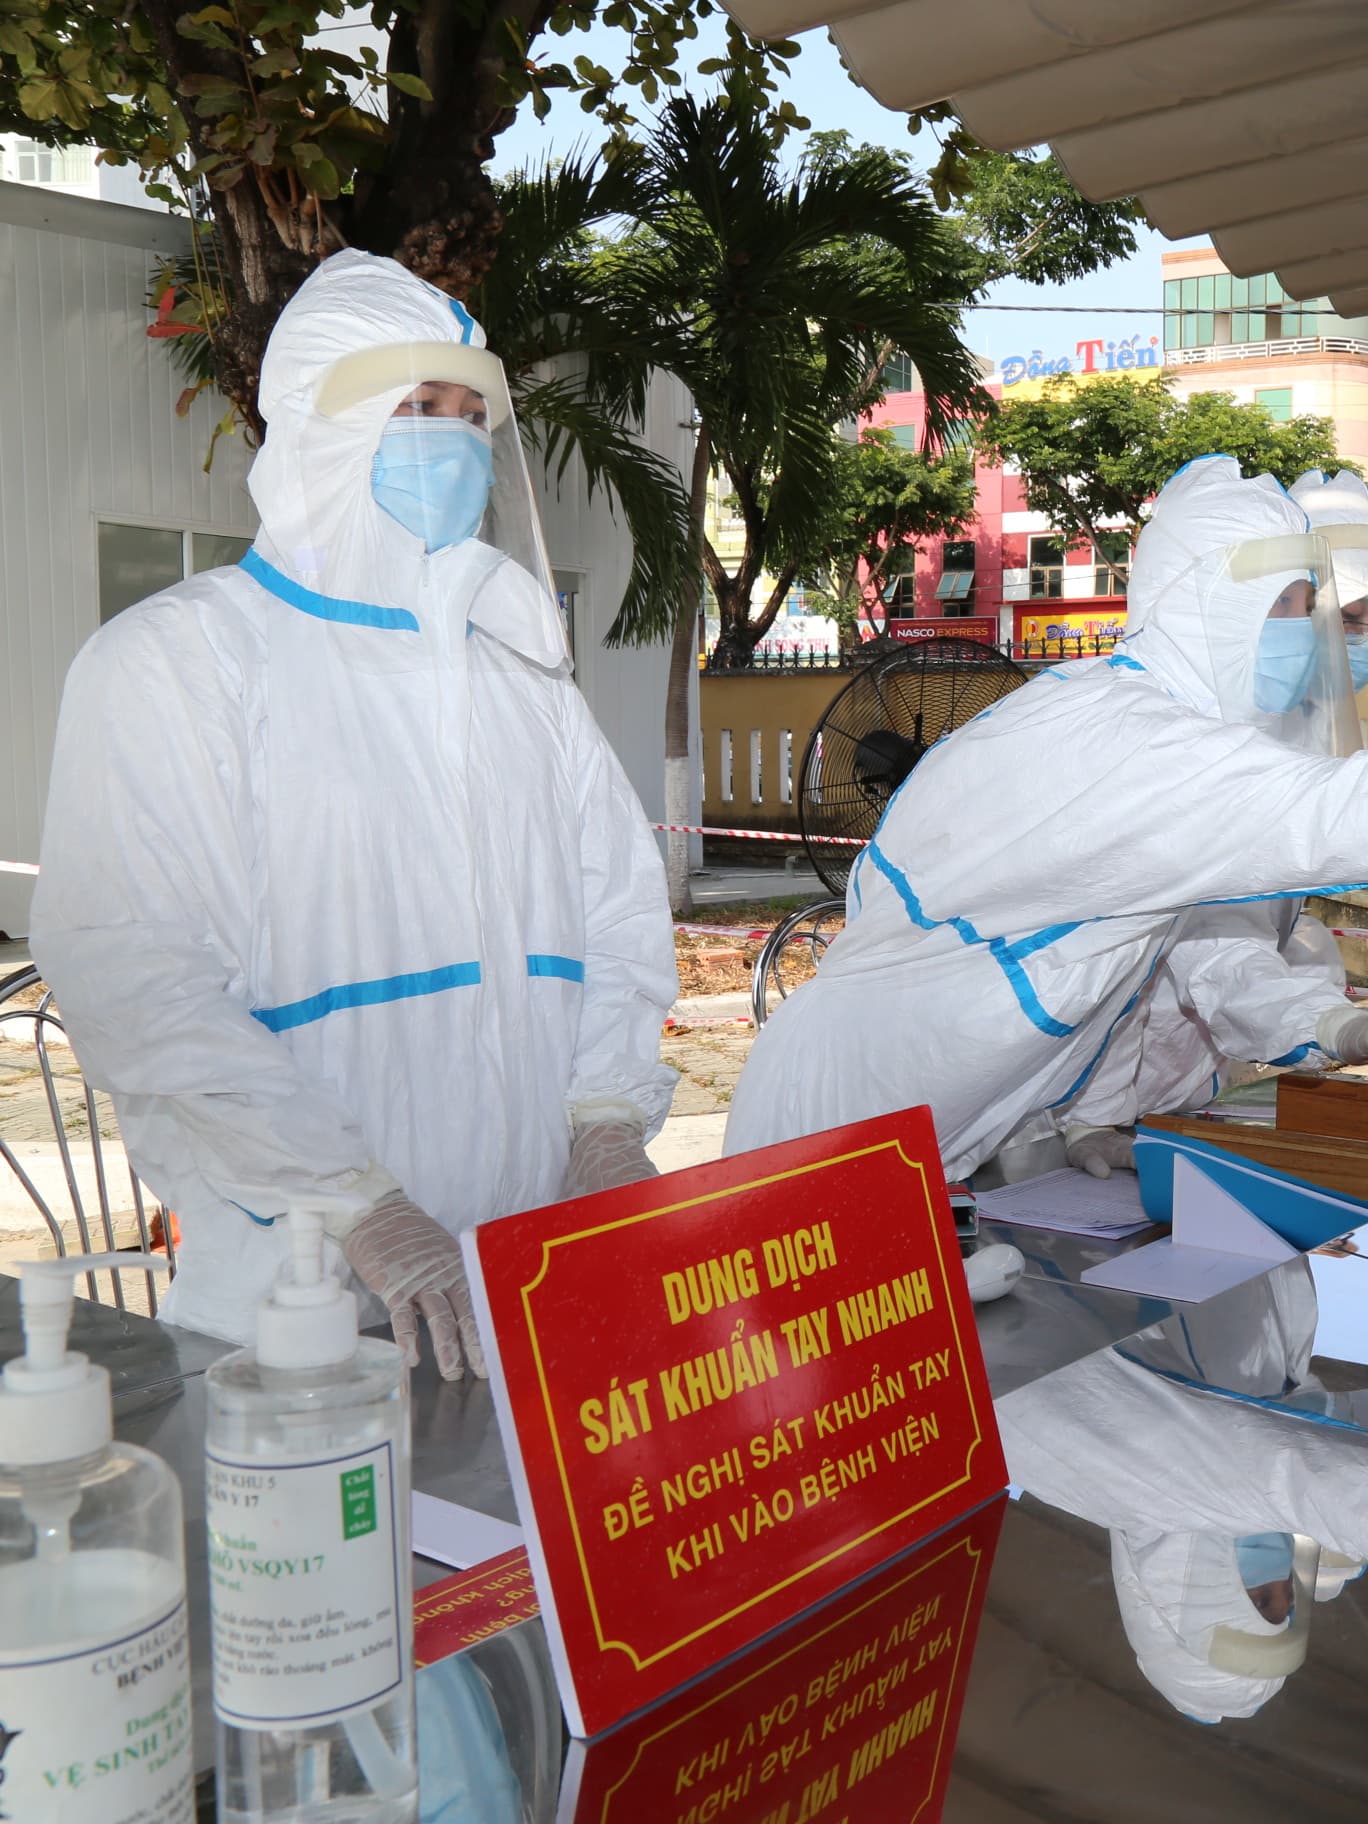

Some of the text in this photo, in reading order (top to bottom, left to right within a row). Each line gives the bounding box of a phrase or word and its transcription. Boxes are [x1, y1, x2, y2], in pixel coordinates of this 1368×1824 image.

[1076, 334, 1159, 374] Tiến
[897, 627, 989, 638] NASCO EXPRESS
[662, 1221, 838, 1325] DUNG DỊCH
[580, 1268, 934, 1455] SÁT KHUẨN TAY NHANH
[603, 1349, 951, 1541] ĐỀ NGHỊ SÁT KHUẨN TAY
[666, 1413, 941, 1579] KHI VÀO BỆNH VIỆN
[244, 1495, 259, 1507] 17
